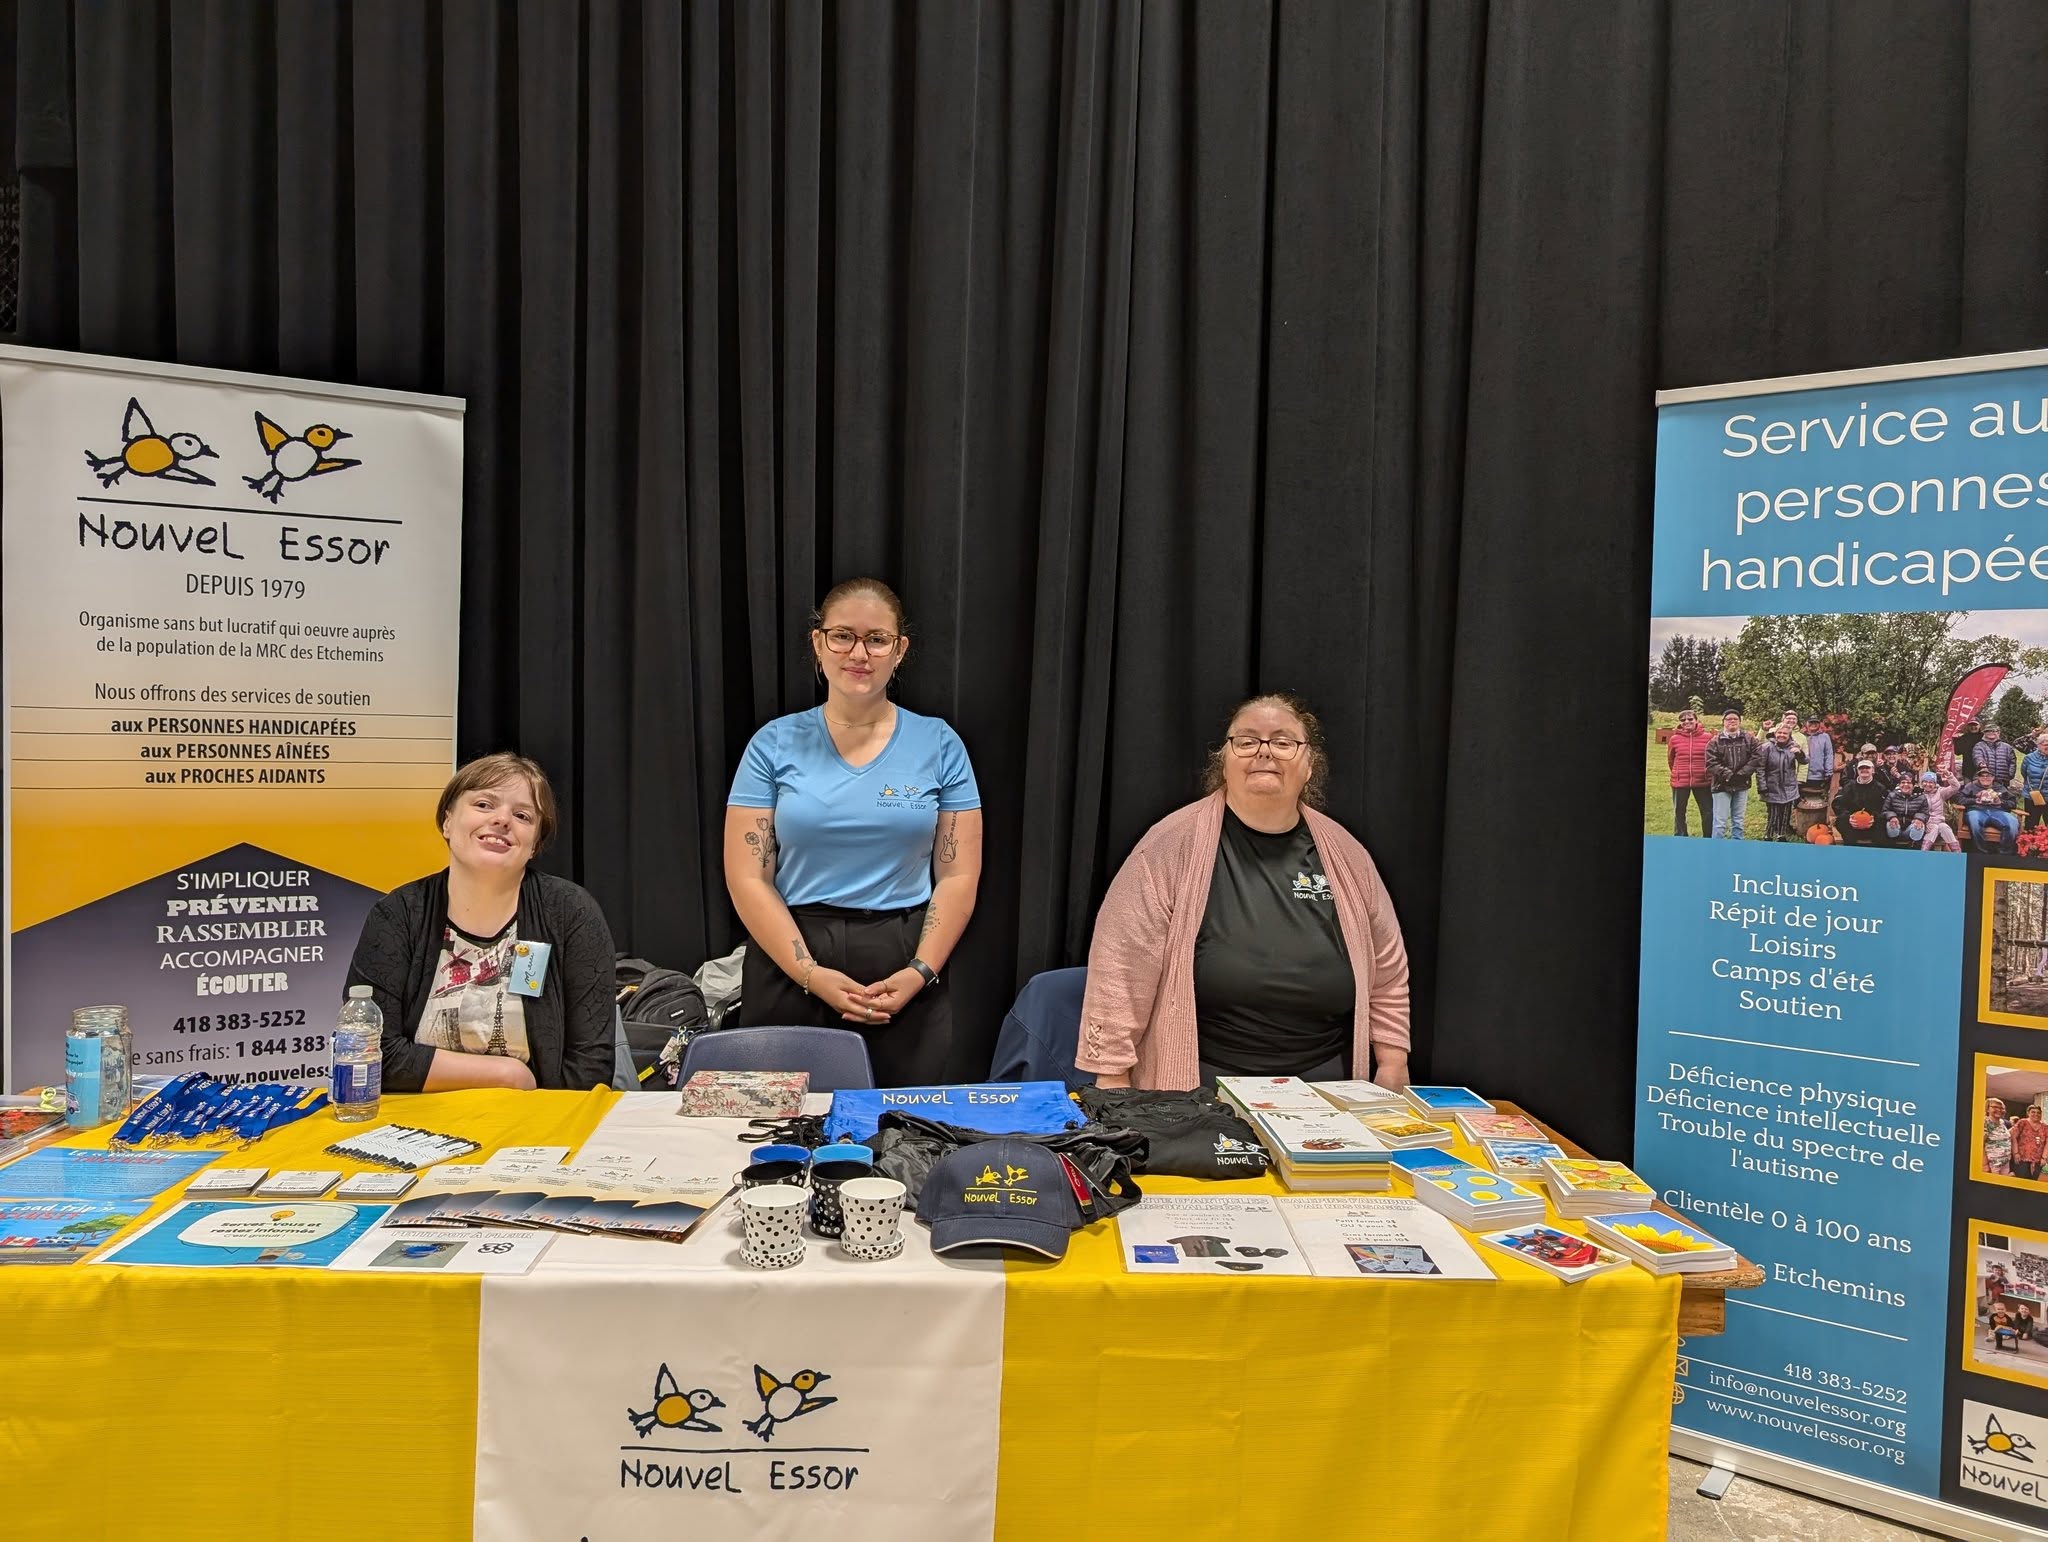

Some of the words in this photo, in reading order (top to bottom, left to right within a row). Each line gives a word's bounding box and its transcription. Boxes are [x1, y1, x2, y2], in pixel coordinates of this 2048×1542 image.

[1722, 402, 1948, 458] Service
[78, 512, 244, 560] Nouvel
[280, 526, 390, 566] Essor
[186, 573, 255, 598] DEPUIS
[260, 578, 306, 600] 1979
[79, 610, 160, 631] Organisme
[163, 617, 195, 632] sans
[198, 616, 224, 634] but
[227, 617, 276, 636] lucratif
[279, 620, 301, 640] qui
[304, 625, 349, 639] oeuvre
[352, 624, 396, 642] auprès
[96, 636, 115, 652] de
[118, 637, 132, 653] la
[136, 638, 216, 658] population
[218, 640, 236, 657] de
[239, 642, 252, 658] la
[256, 643, 287, 660] MRC
[290, 644, 313, 660] des
[316, 645, 384, 663] Etchemins
[95, 682, 136, 702] Nous
[140, 684, 198, 703] offrons
[201, 685, 228, 704] des
[231, 687, 292, 704] services
[295, 688, 314, 706] de
[317, 688, 371, 707] soutien
[111, 719, 144, 734] aux
[147, 717, 244, 734] PERSONNES
[248, 716, 356, 736] HANDICAPÉES
[140, 745, 172, 760] aux
[176, 743, 272, 760] PERSONNES
[275, 740, 330, 760] AÎNÉES
[144, 770, 176, 784] aux
[180, 768, 254, 784] PROCHES
[258, 768, 326, 784] AIDANTS
[176, 870, 310, 890] S'IMPLIQUER
[1732, 873, 1859, 902] Inclusion
[166, 894, 320, 917] PRÉVENIR
[1708, 901, 1776, 929] Répit
[1784, 906, 1817, 929] de
[1824, 910, 1884, 936] jour
[156, 920, 328, 944] RASSEMBLER
[160, 946, 324, 970] ACCOMPAGNER
[1748, 934, 1836, 960] Loisirs
[196, 970, 289, 996] ÉCOUTER
[1711, 959, 1802, 990] Camps
[1809, 968, 1876, 994] d'été
[1739, 990, 1842, 1021] Soutien
[173, 1014, 211, 1034] 418
[215, 1009, 306, 1032] 383-5252
[145, 1049, 185, 1065] sans
[188, 1042, 230, 1062] frais:
[235, 1041, 245, 1058] 1
[250, 1038, 288, 1057] 844
[882, 1090, 954, 1106] Nouvel
[968, 1090, 1019, 1104] Essor
[1668, 1062, 1792, 1098] Déficience
[1800, 1083, 1917, 1118] physique
[1646, 1086, 1769, 1120] Déficience
[1776, 1105, 1941, 1147] intellectuelle
[1658, 1112, 1746, 1143] Trouble
[1754, 1128, 1784, 1150] du
[1791, 1137, 1884, 1166] spectre
[1892, 1149, 1924, 1173] de
[1216, 1155, 1248, 1166] Nouvel
[1730, 1148, 1839, 1185] l'autisme
[10, 1203, 60, 1212] road
[60, 1204, 98, 1213] trip
[964, 1192, 1000, 1204] Nouvel
[1009, 1192, 1038, 1206] Essor
[1663, 1189, 1764, 1226] Clientèle
[1771, 1210, 1788, 1229] 0
[1795, 1214, 1808, 1234] à
[1815, 1218, 1860, 1244] 100
[1867, 1232, 1912, 1254] ans
[1773, 1263, 1906, 1308] Etchemins
[1783, 1362, 1812, 1382] 418
[1818, 1370, 1908, 1405] 383-5252
[1709, 1370, 1907, 1438] info@nouvelessor.org
[1706, 1400, 1906, 1466] www.nouvelessor.org
[620, 1458, 742, 1492] Nouvel
[770, 1460, 859, 1490] Essor
[1962, 1464, 2046, 1502] Nouvel
